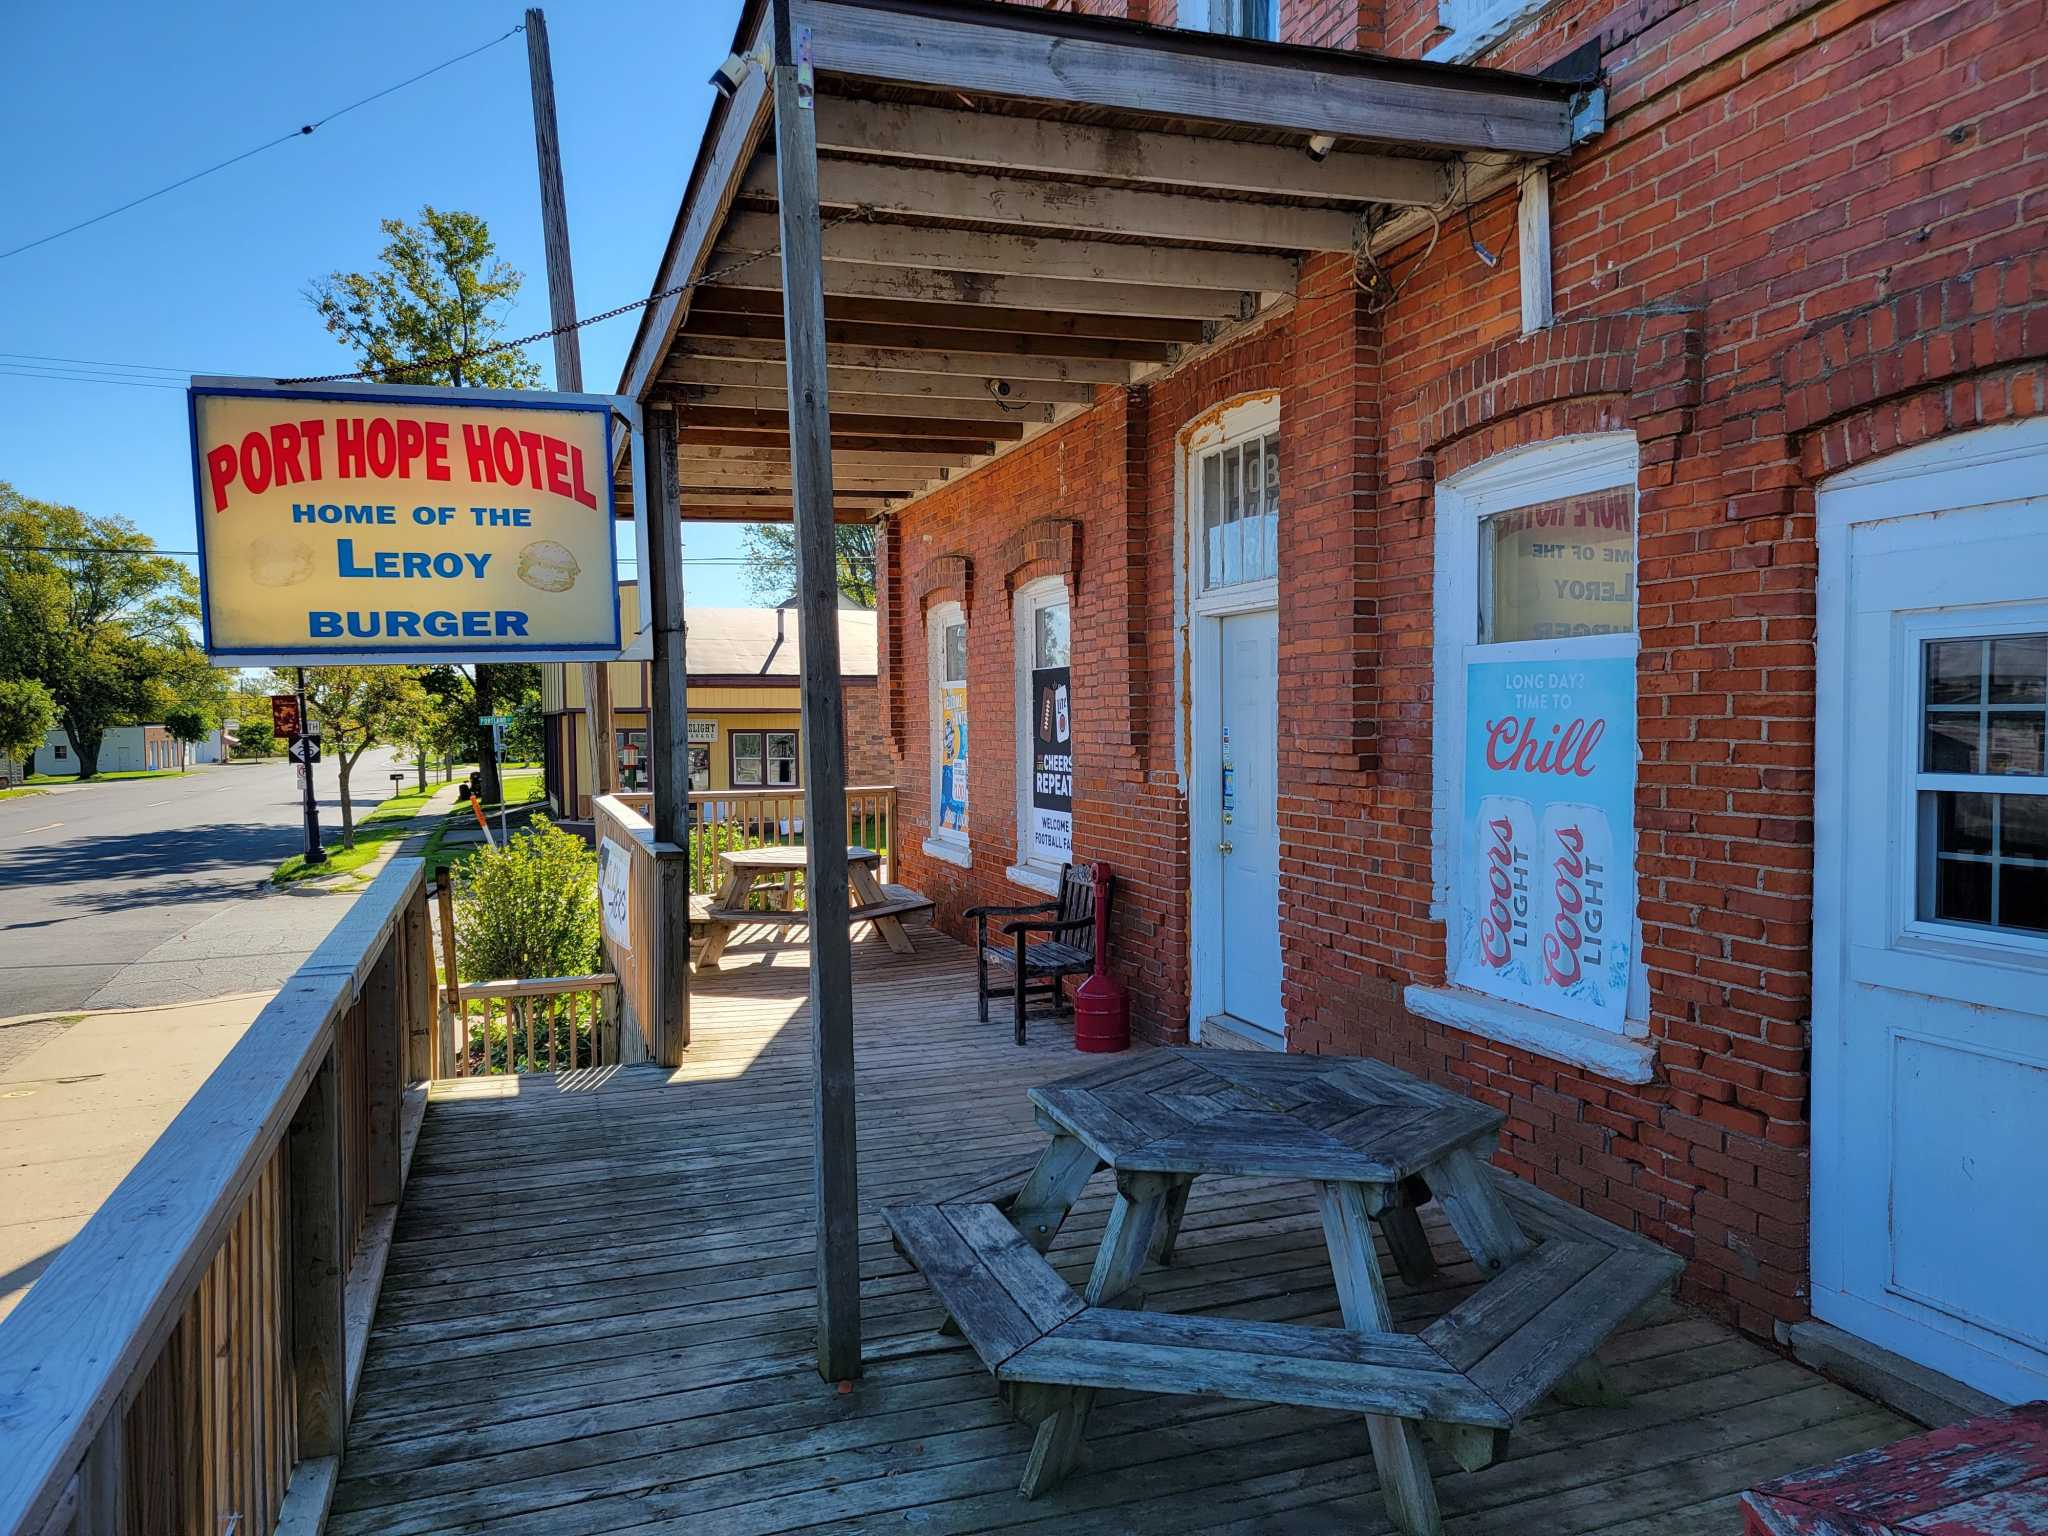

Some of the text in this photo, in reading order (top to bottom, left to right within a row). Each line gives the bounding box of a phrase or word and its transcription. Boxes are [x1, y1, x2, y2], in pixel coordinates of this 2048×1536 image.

[207, 417, 597, 513] PORT HOPE HOTEL
[292, 504, 532, 527] HOME OF THE
[337, 538, 492, 579] LEROY
[308, 610, 529, 638] BURGER
[1505, 673, 1585, 689] LONG DAY?
[1515, 694, 1572, 709] TIME TO
[1485, 716, 1606, 777] Chill
[1036, 773, 1072, 797] REPEAT
[1035, 831, 1063, 850] FOOTBALL
[1042, 816, 1070, 833] WELCOME
[1480, 816, 1513, 969] Coors
[1513, 845, 1529, 948] LIGHT
[1543, 824, 1584, 988] Coors
[1583, 856, 1604, 966] LIGHT
